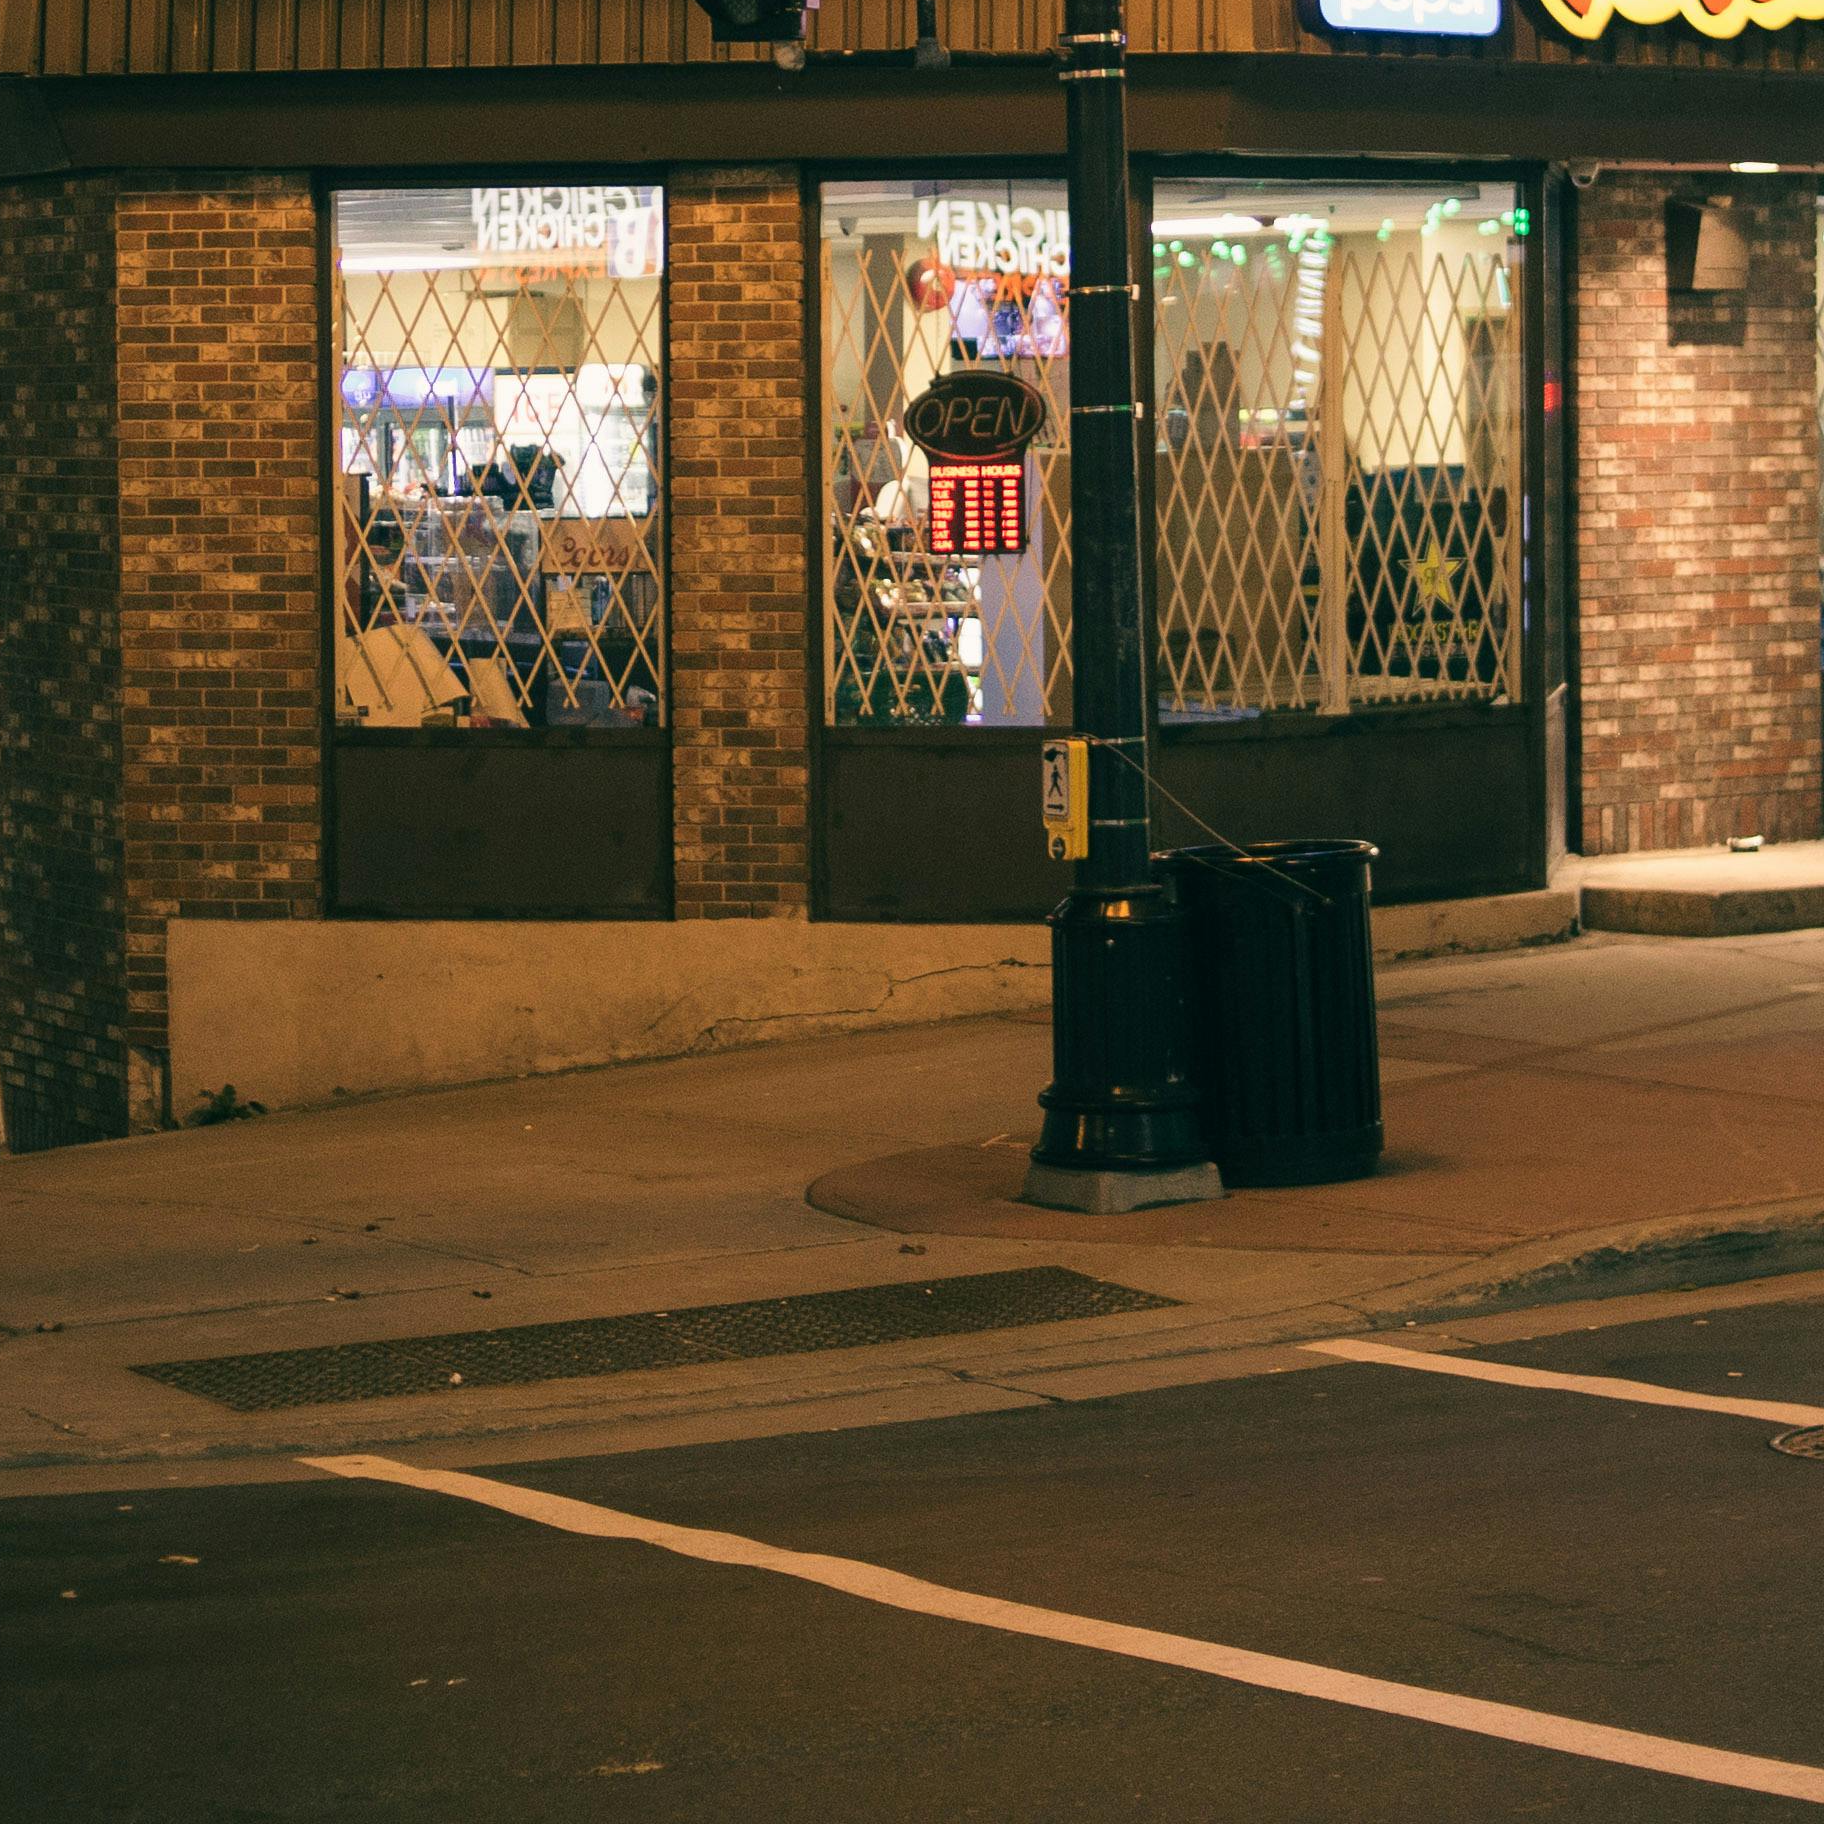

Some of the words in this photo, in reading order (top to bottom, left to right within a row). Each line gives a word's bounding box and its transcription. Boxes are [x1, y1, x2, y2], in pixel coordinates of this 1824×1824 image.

[914, 394, 1032, 440] OPEN
[930, 465, 980, 479] BUSINESS
[980, 464, 1023, 478] HOURS
